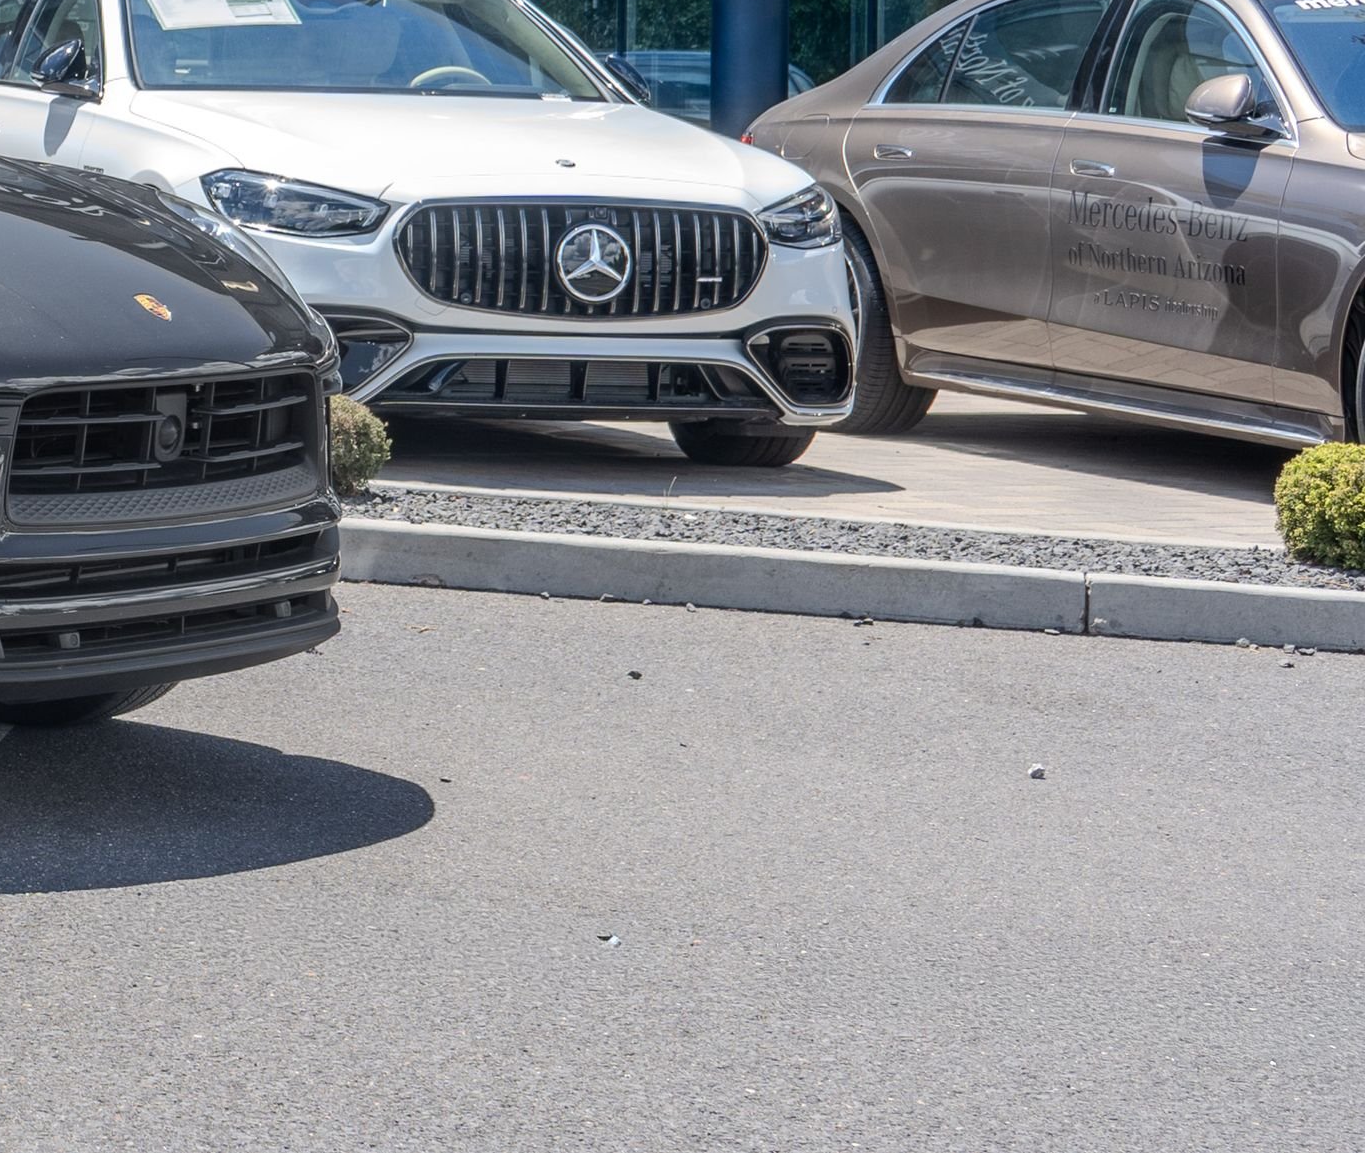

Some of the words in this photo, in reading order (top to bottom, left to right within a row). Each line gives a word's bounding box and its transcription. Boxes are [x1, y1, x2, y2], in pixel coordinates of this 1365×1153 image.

[1068, 190, 1249, 242] Mercedes-Benz
[1068, 241, 1085, 266] of
[1087, 243, 1167, 275] Northern
[1173, 253, 1246, 286] Arizona
[1103, 289, 1160, 312] LAPIS
